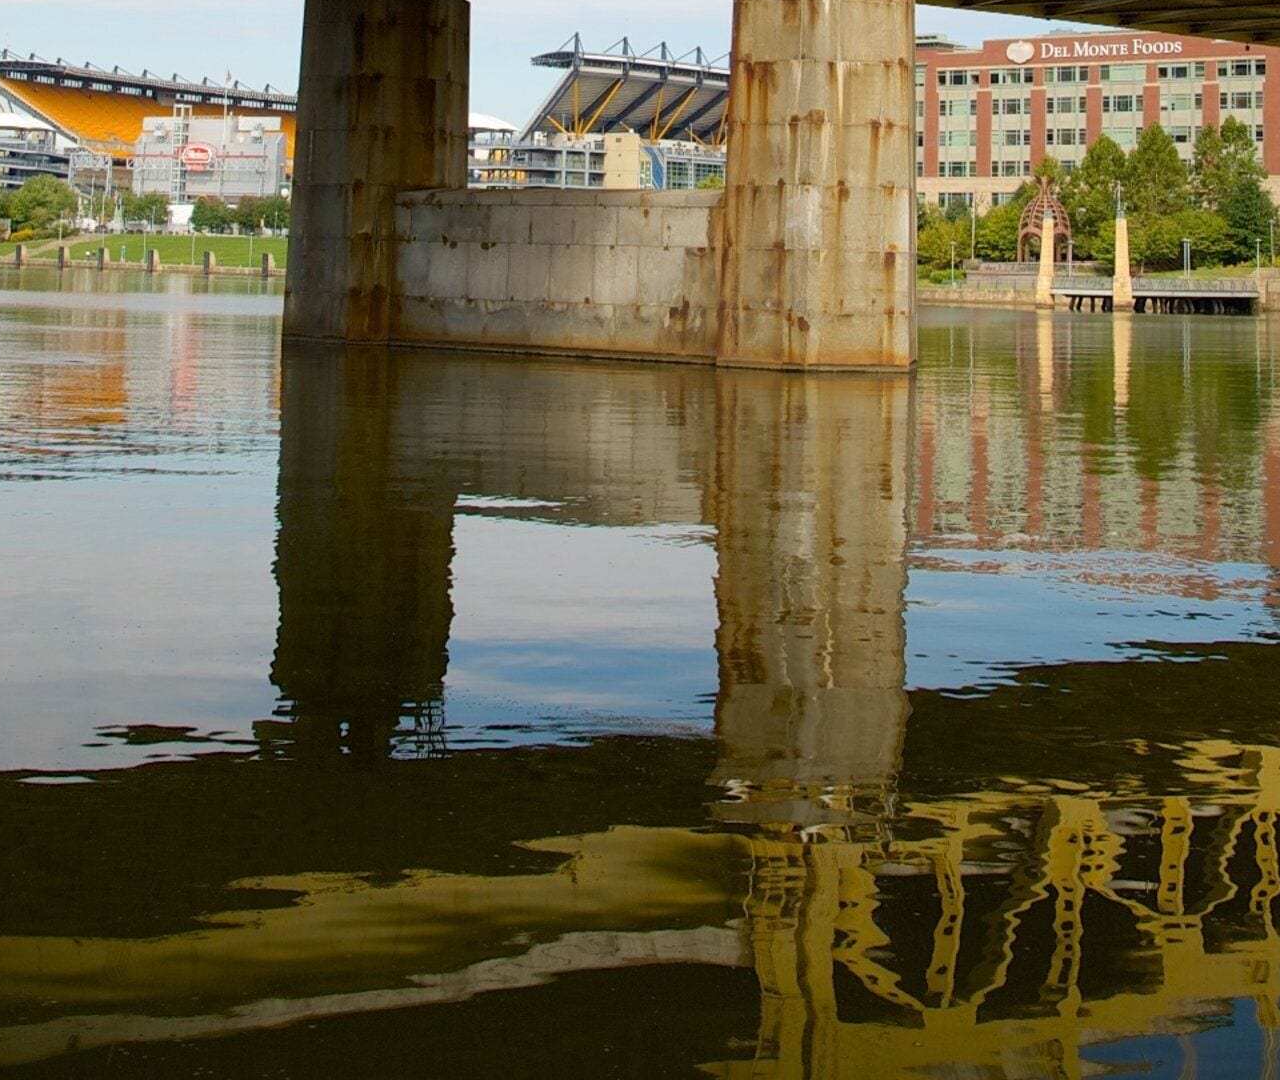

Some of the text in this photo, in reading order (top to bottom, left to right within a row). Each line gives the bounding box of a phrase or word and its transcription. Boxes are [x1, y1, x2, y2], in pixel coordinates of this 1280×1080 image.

[1040, 39, 1183, 59] DEL MONTE FOODS
